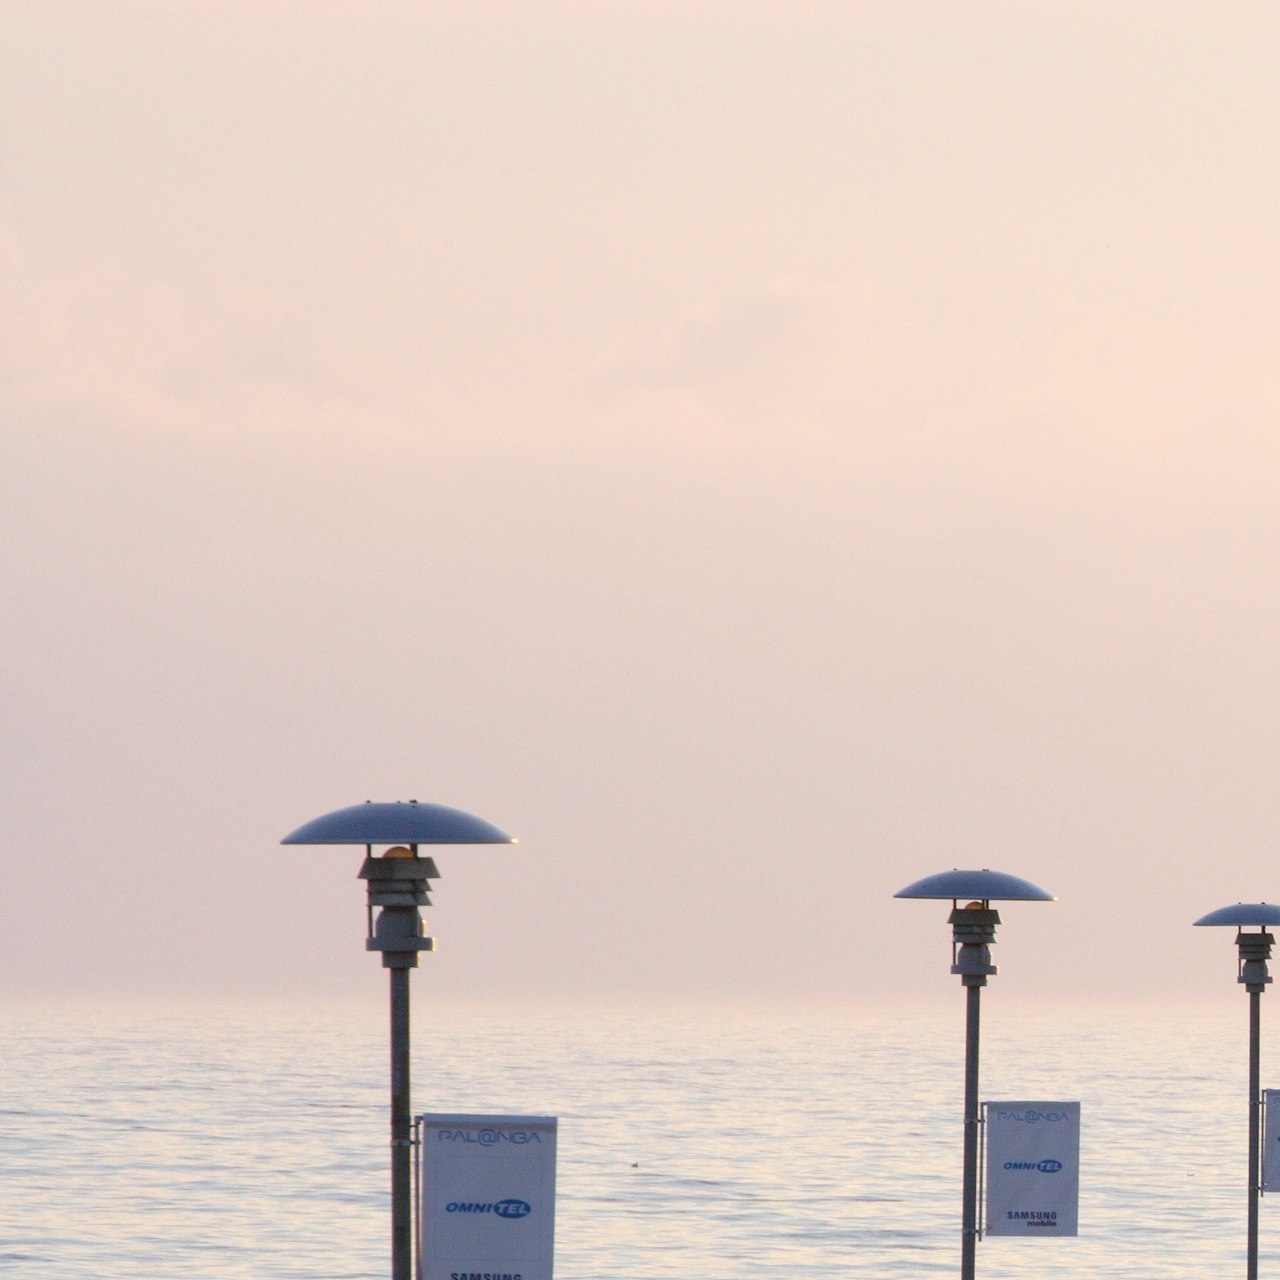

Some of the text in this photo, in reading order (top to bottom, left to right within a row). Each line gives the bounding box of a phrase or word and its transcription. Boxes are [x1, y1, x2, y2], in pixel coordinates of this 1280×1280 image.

[438, 1129, 542, 1147] PAL@NGA
[1003, 1159, 1062, 1173] OMNITEL
[445, 1199, 531, 1219] OMNITEL
[1007, 1211, 1057, 1220] SAMSUNG
